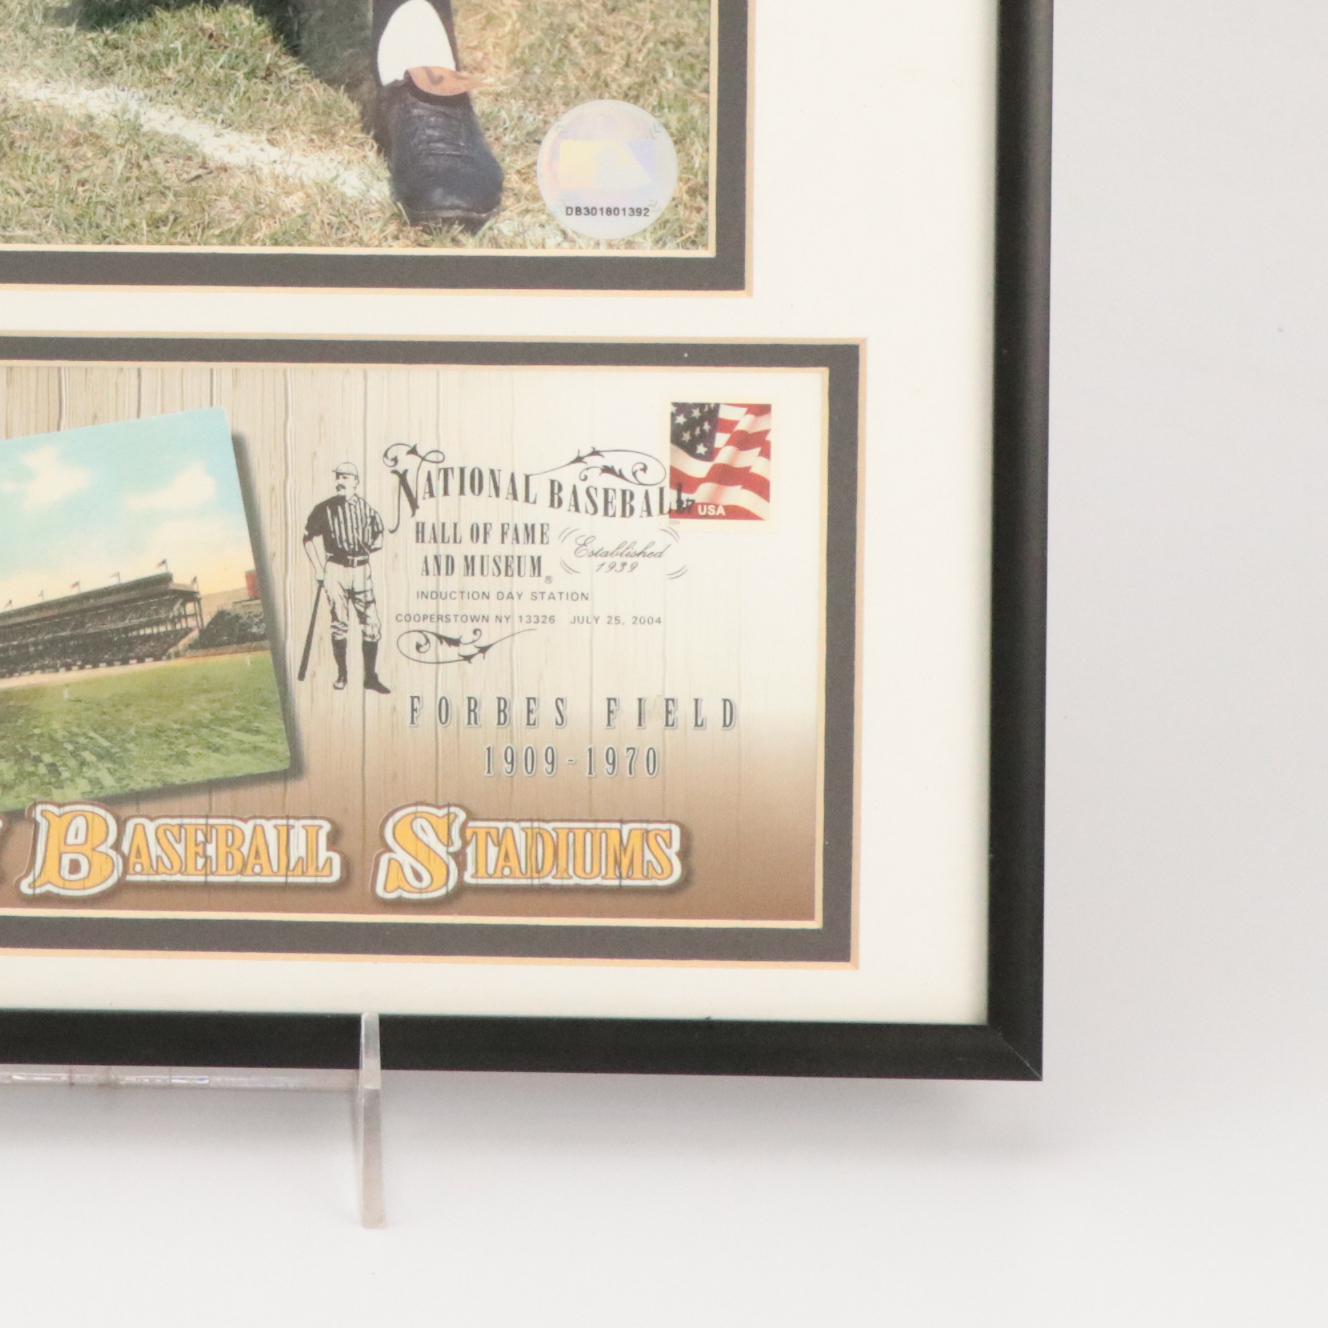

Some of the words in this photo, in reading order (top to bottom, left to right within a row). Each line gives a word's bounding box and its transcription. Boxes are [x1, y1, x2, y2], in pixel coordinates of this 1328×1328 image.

[388, 459, 537, 533] NATIONAL
[548, 479, 687, 519] BASEBALL
[697, 504, 726, 516] USA
[415, 521, 462, 544] HALL
[469, 522, 492, 545] OF
[500, 522, 550, 545] FAME
[574, 536, 672, 559] Established
[421, 554, 455, 577] AND
[596, 561, 639, 573] 1939
[416, 590, 490, 601] INDUCTION
[496, 591, 523, 601] DAY
[530, 591, 590, 601] STATION
[395, 613, 489, 623] COOPERSTOWN
[495, 614, 511, 623] NY
[518, 615, 556, 624] 13326
[569, 615, 600, 625] JULY
[606, 615, 625, 626] 25,
[631, 615, 662, 625] 2004
[409, 695, 568, 727] FORBES
[605, 697, 735, 728] FIELD
[483, 746, 658, 776] 1909-1970
[24, 806, 336, 893] BASEBALL
[379, 807, 677, 896] STADIUMS
